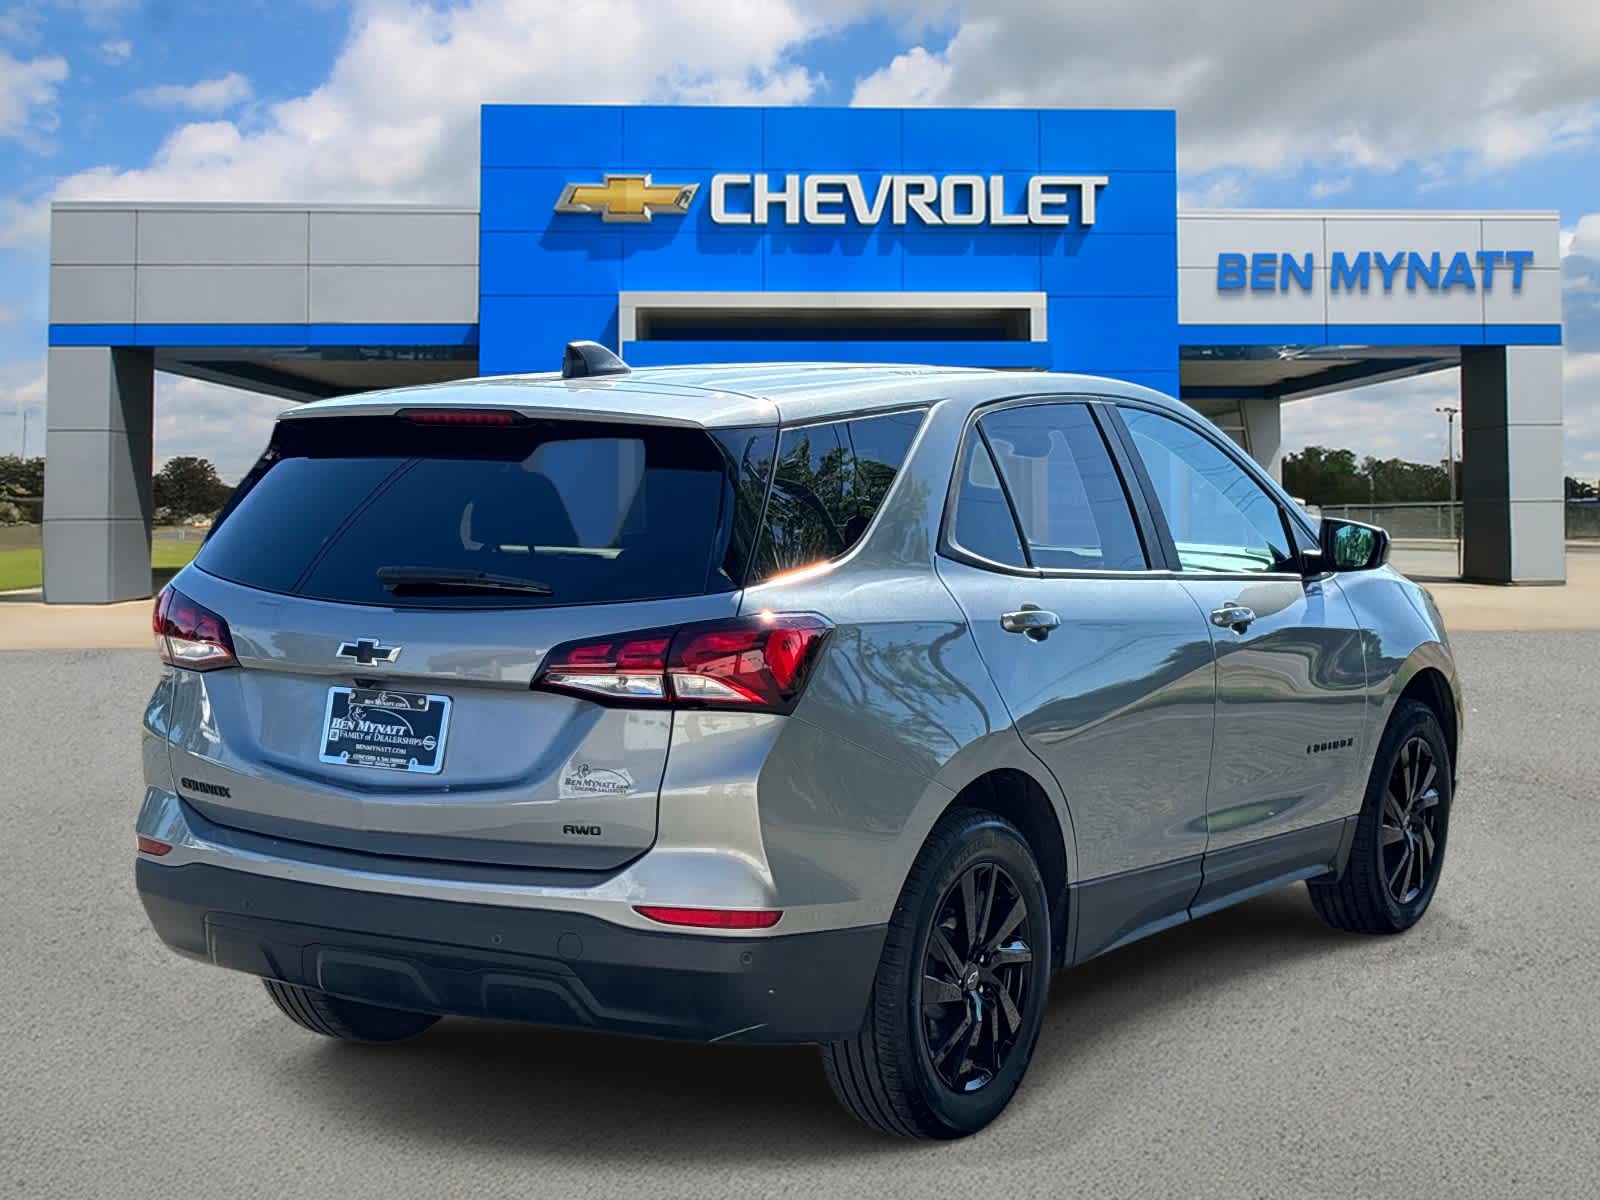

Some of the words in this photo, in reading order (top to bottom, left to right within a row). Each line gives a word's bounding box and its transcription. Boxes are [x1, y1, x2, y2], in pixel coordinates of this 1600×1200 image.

[710, 173, 1109, 225] CHEVROLET
[1217, 252, 1314, 290] BEN
[1330, 250, 1534, 290] MYNATT
[332, 717, 354, 730] BEN
[357, 720, 407, 735] MYNATT
[340, 730, 364, 740] FAMILY
[365, 733, 371, 741] of
[373, 734, 422, 746] DEALERSHIPS
[565, 777, 583, 787] BEN
[563, 825, 601, 836] AWD
